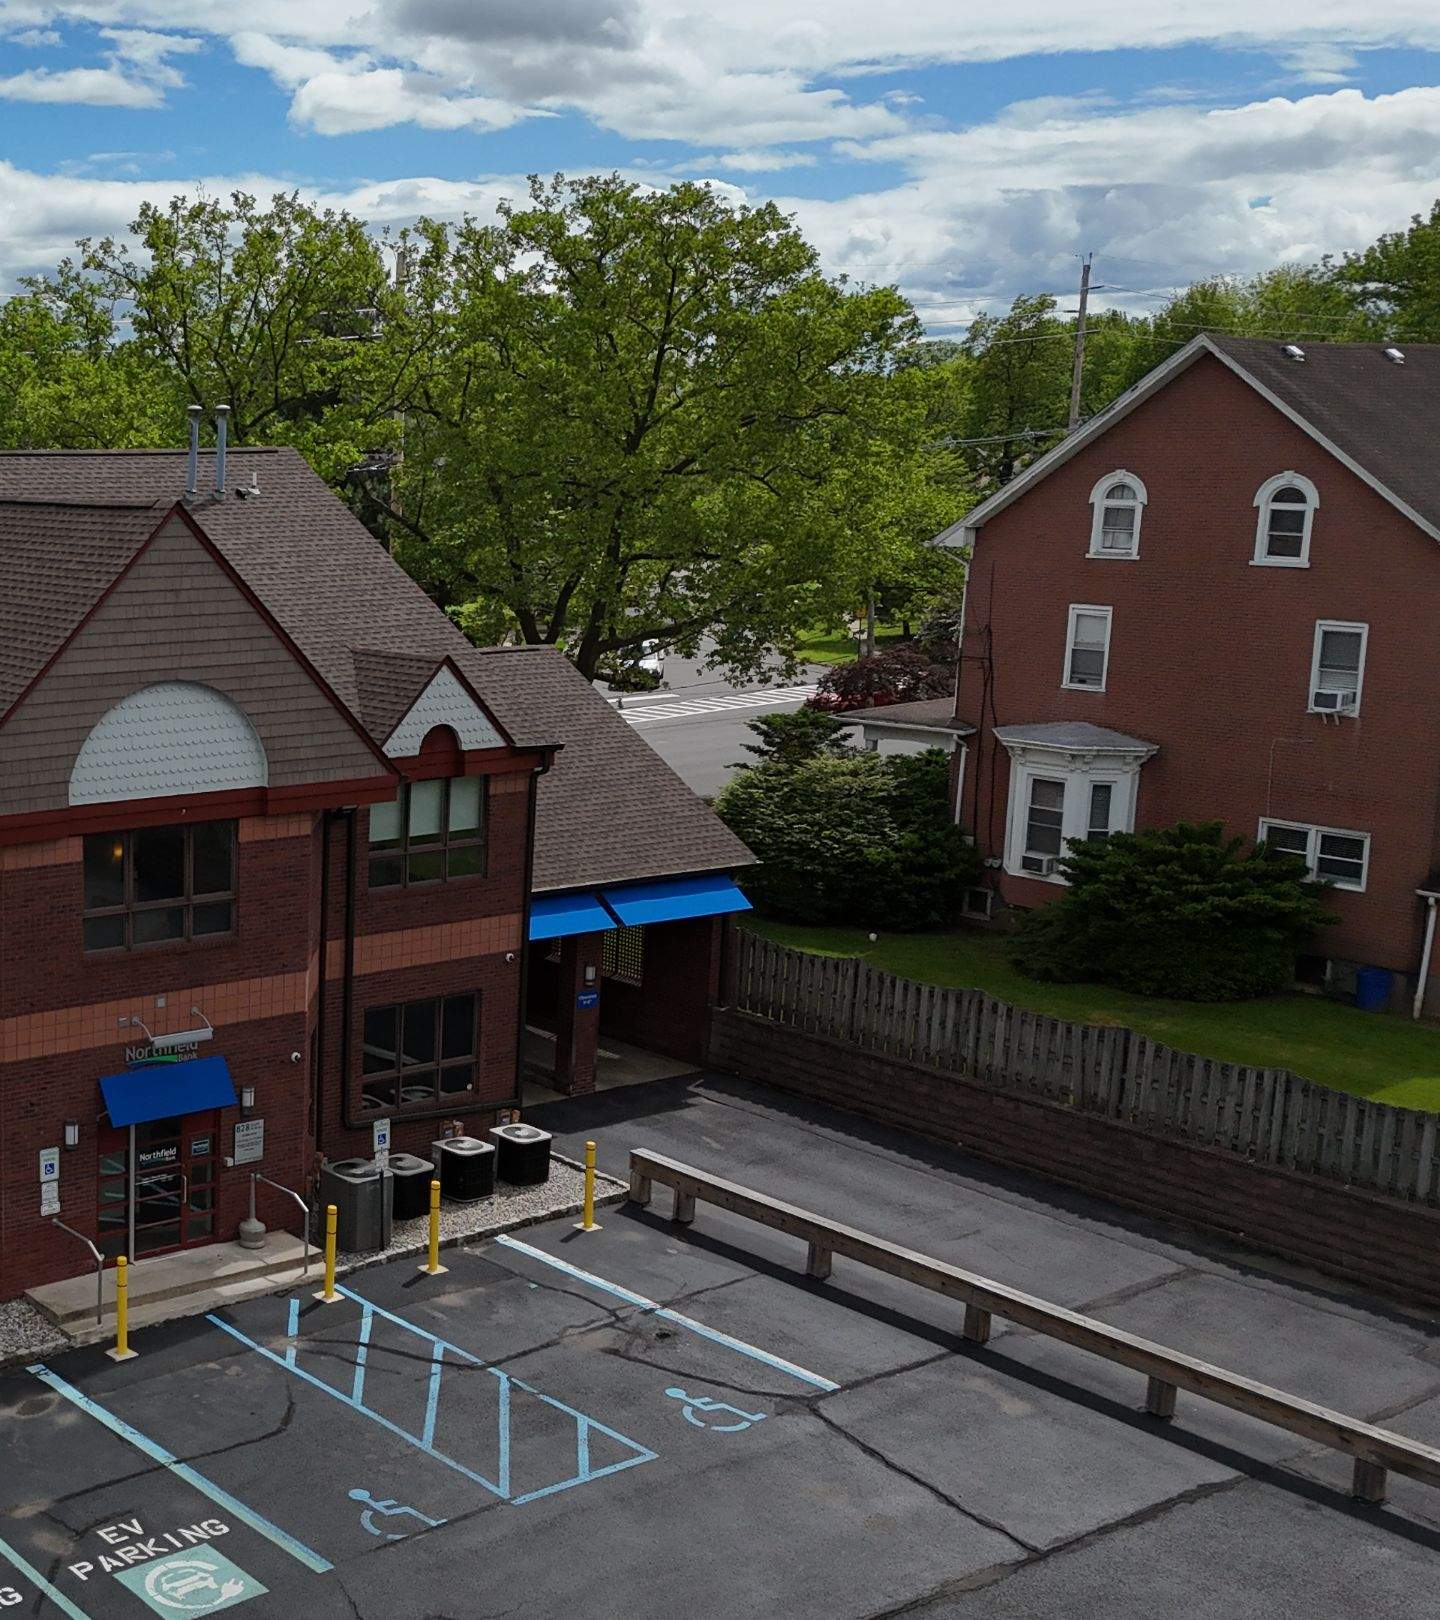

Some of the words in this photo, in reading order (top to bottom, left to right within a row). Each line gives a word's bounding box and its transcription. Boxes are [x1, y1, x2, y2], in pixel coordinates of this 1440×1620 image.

[139, 1147, 177, 1161] Northfield
[96, 1518, 145, 1545] EV
[67, 1518, 231, 1581] PARKING
